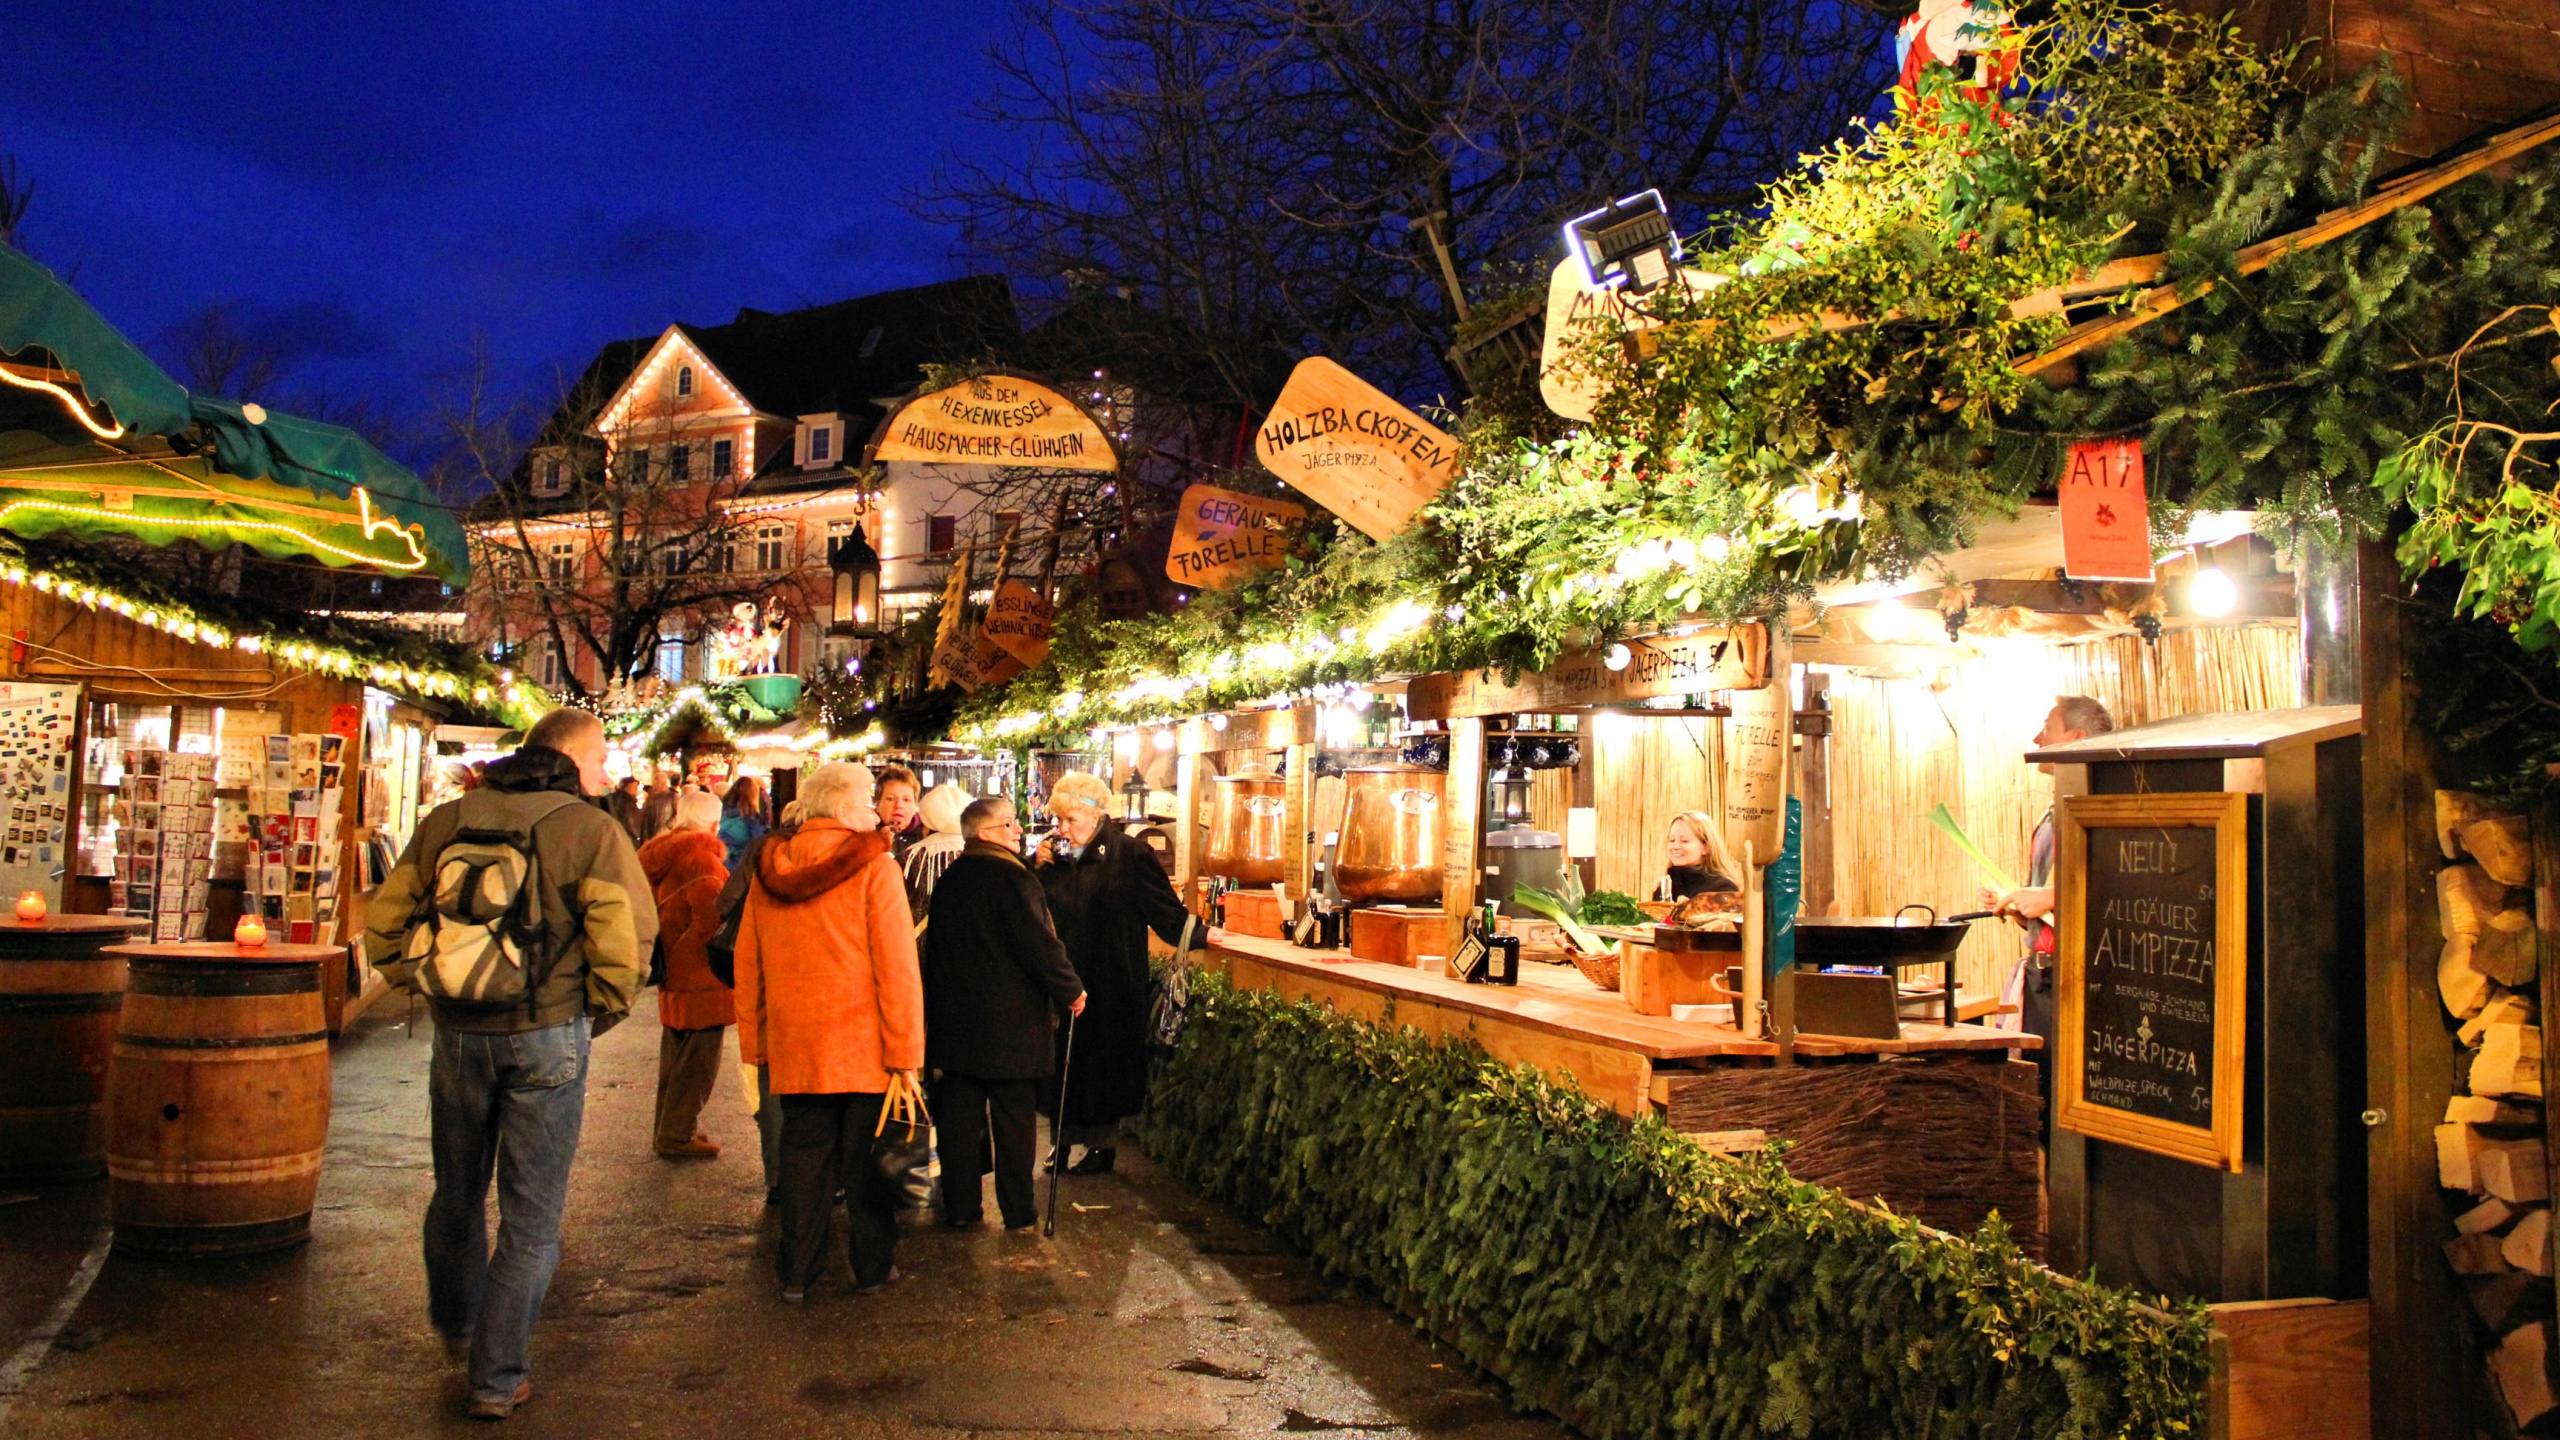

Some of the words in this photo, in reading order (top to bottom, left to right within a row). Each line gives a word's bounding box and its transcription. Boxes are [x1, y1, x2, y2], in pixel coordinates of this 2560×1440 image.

[940, 396, 1052, 428] HEXENKESSEL
[973, 388, 992, 400] AUS
[997, 388, 1018, 403] DEM
[902, 423, 1084, 458] HAUSMACHER-GLÜHWEIN
[1264, 407, 1451, 469] HOLZBACKOFEN
[2071, 451, 2132, 487] A17
[2104, 896, 2198, 933] ALLGÄUER
[2094, 927, 2217, 985] ALMPIZZA
[2140, 1001, 2157, 1013] UND
[2088, 1060, 2102, 1072] MIT
[2092, 1024, 2197, 1077] JÄGERPIZZA
